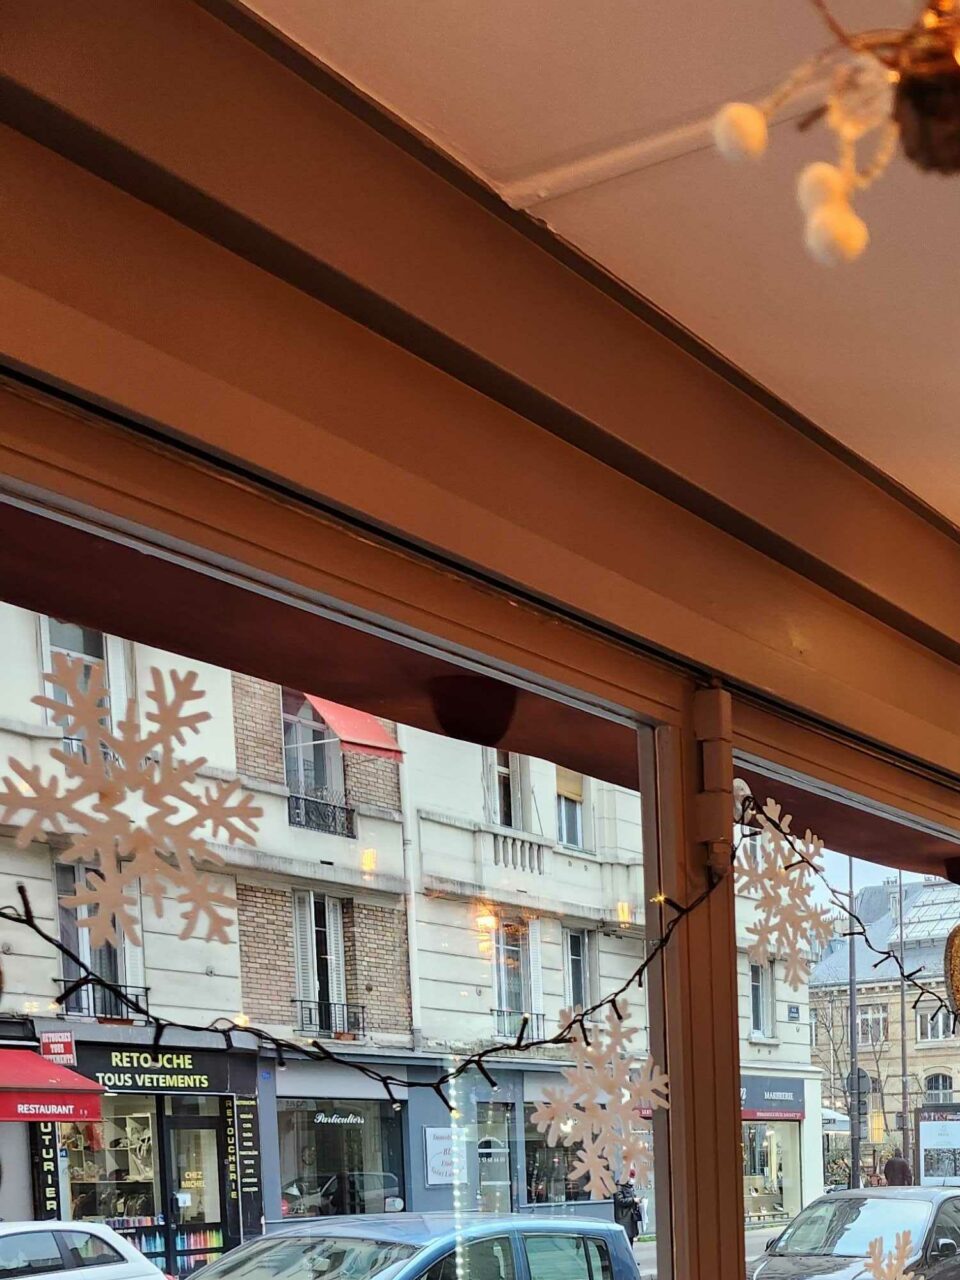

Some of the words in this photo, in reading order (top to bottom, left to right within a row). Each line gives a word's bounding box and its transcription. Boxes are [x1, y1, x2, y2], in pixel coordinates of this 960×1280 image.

[50, 1043, 65, 1053] TOUS
[96, 1072, 133, 1087] TOUS
[134, 1074, 209, 1088] VETEMENTS
[17, 1104, 75, 1114] RESTAURANT
[313, 1112, 365, 1124] Particuliers
[225, 1100, 238, 1199] RETOUCHERIE
